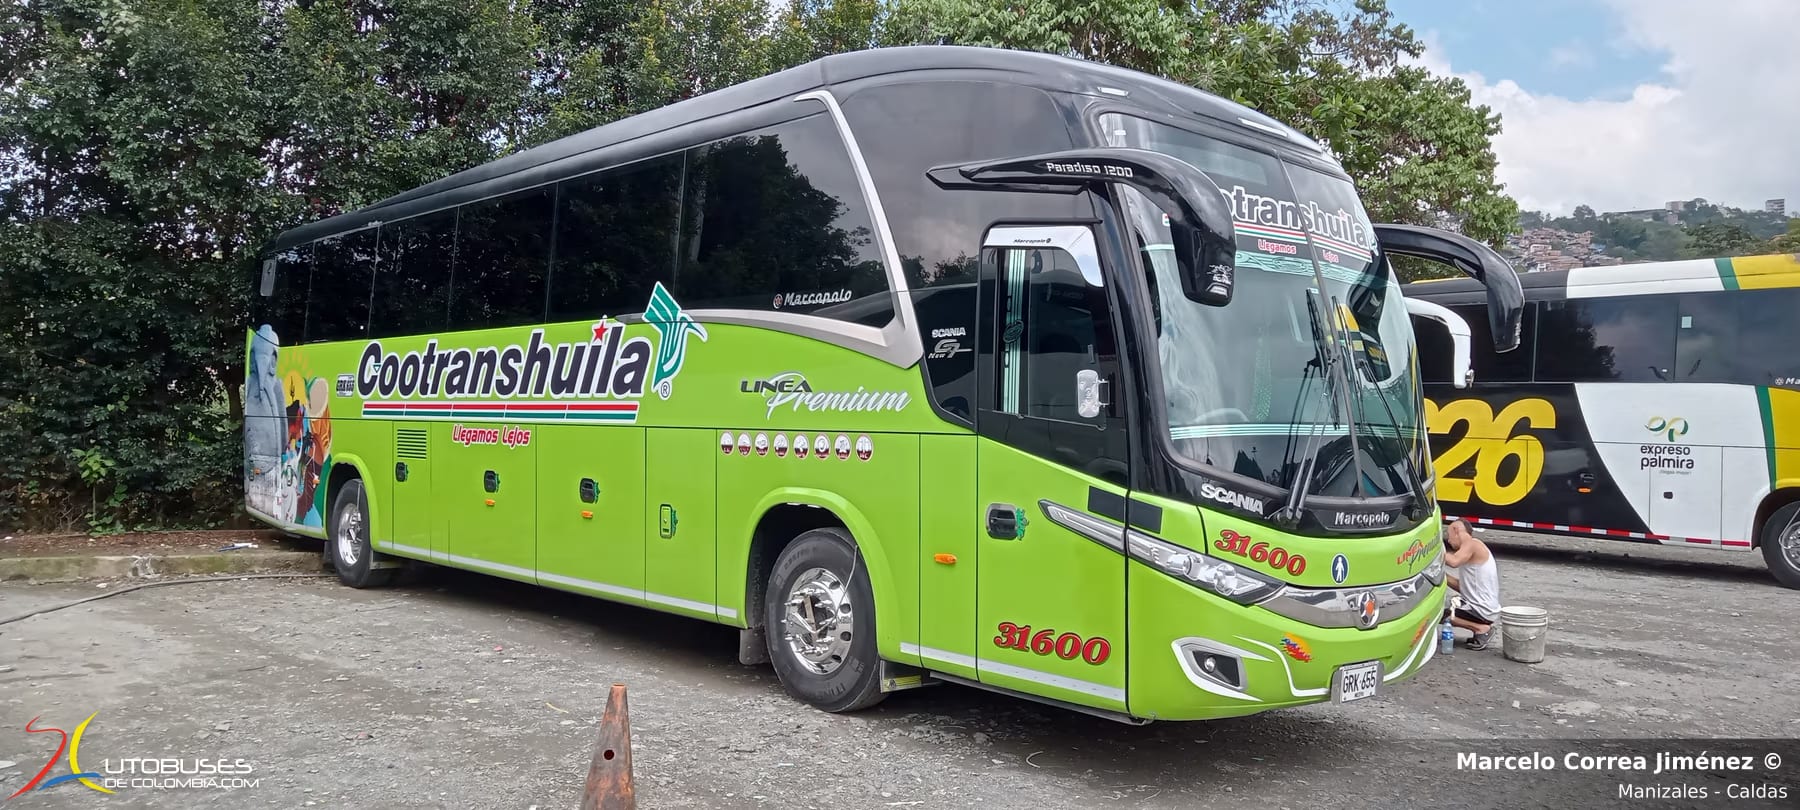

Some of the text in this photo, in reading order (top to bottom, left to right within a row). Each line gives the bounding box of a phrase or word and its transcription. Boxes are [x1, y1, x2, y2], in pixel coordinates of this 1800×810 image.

[1046, 162, 1133, 178] Paradiso 1200
[1257, 239, 1297, 255] Llegamos
[783, 288, 853, 306] Marcopolo
[931, 326, 967, 338] SCANIA
[357, 322, 652, 398] Cootranshuila
[740, 379, 813, 394] LINEA
[761, 373, 912, 420] Premium
[452, 425, 531, 448] Llegamos Lejos
[1640, 444, 1691, 457] expreso
[1640, 455, 1695, 470] palmira
[1200, 482, 1264, 516] SCANIA
[1334, 511, 1390, 527] Marcopolo
[1214, 529, 1307, 577] 31600
[993, 621, 1112, 666] 31600
[1342, 670, 1377, 693] GRK 655
